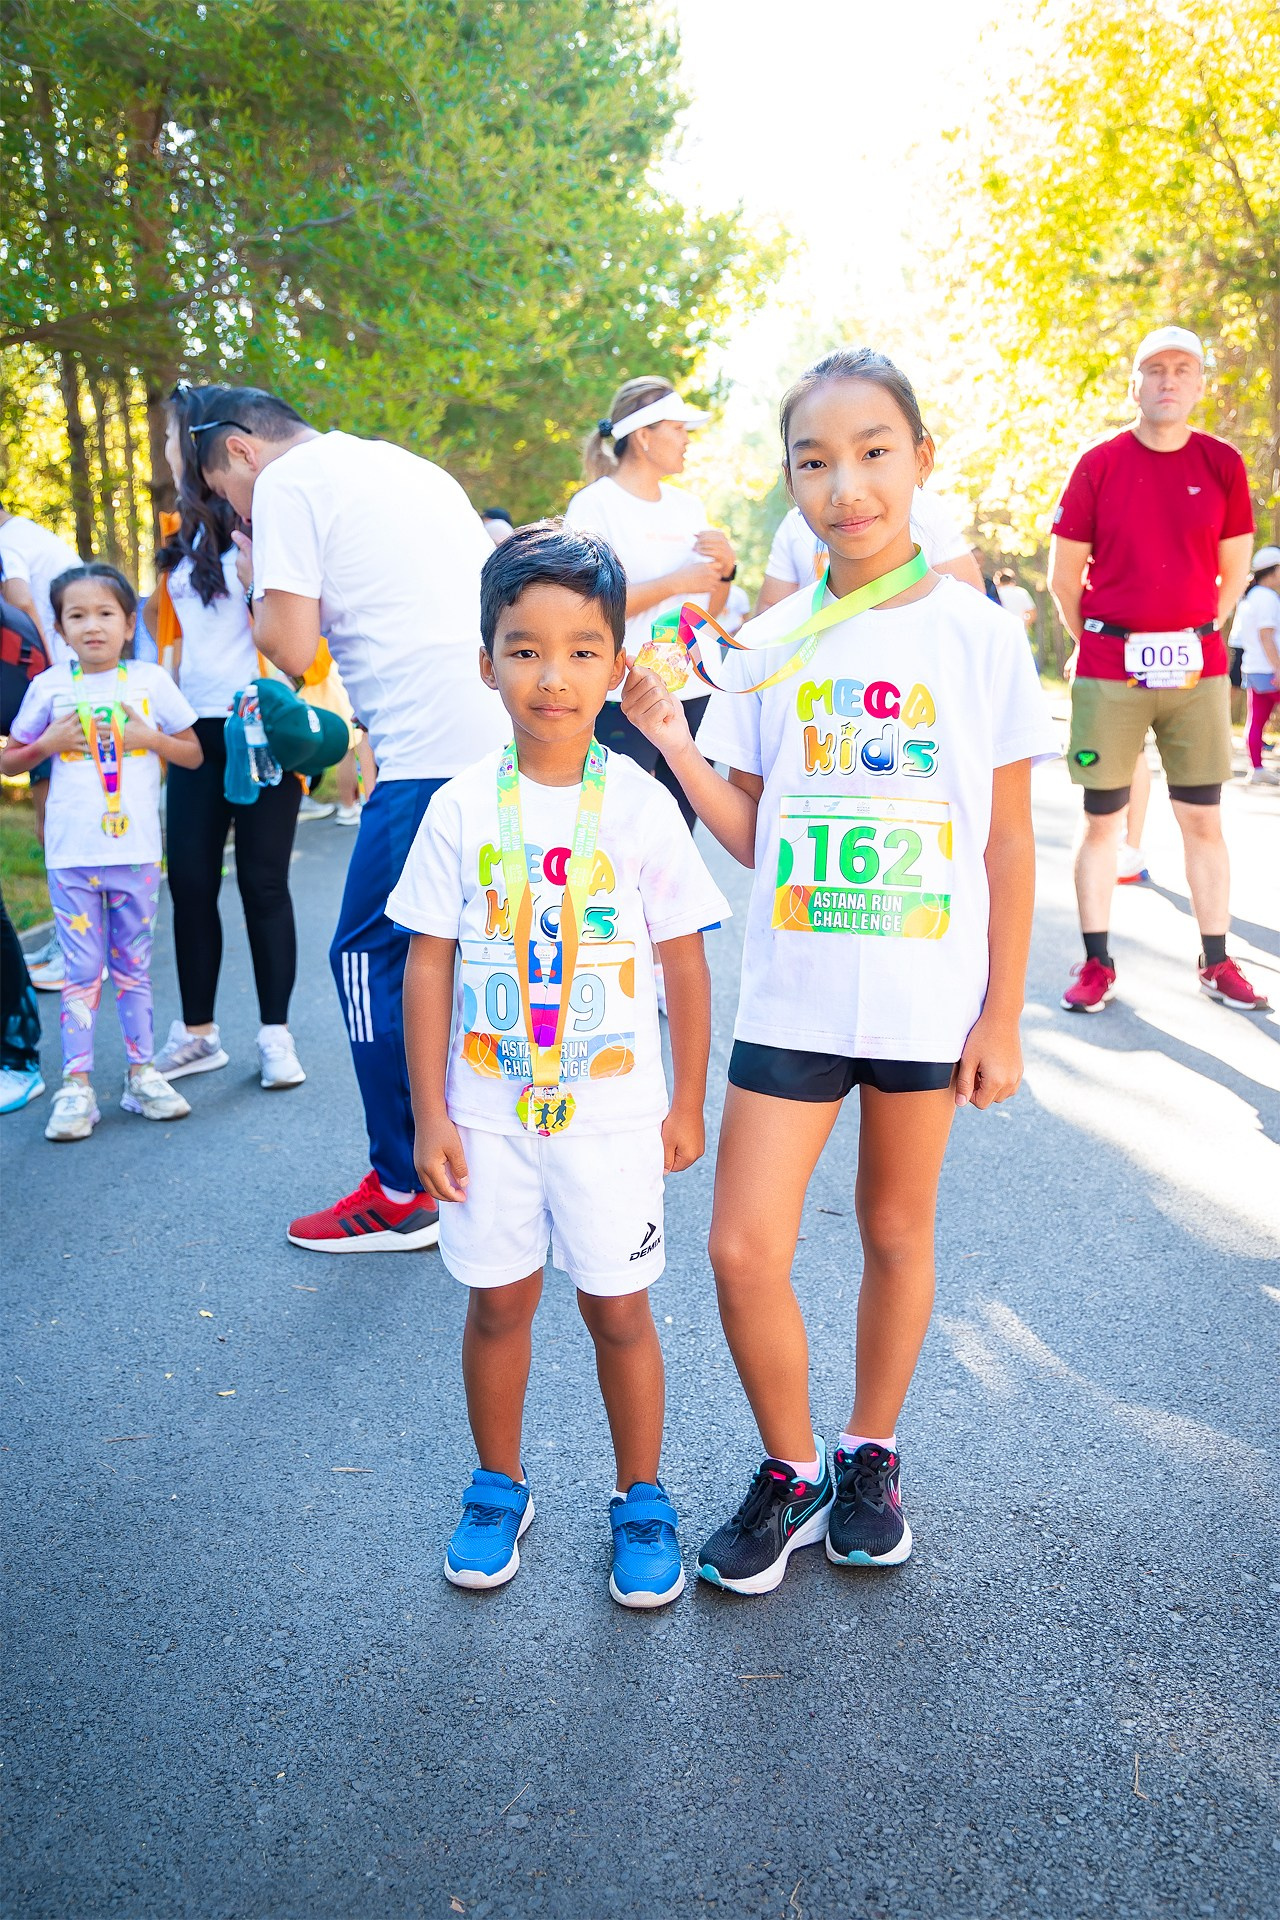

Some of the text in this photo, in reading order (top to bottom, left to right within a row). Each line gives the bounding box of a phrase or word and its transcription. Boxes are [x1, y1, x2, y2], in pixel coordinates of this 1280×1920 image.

[1142, 645, 1189, 667] 005
[797, 678, 936, 730] MEGA
[807, 825, 922, 887] 162
[813, 891, 903, 913] ASTANA RUN
[813, 910, 903, 932] CHALLENGE
[485, 972, 606, 1032] 09
[501, 1040, 589, 1059] ASTA RUN
[503, 1058, 589, 1078] CHANGE
